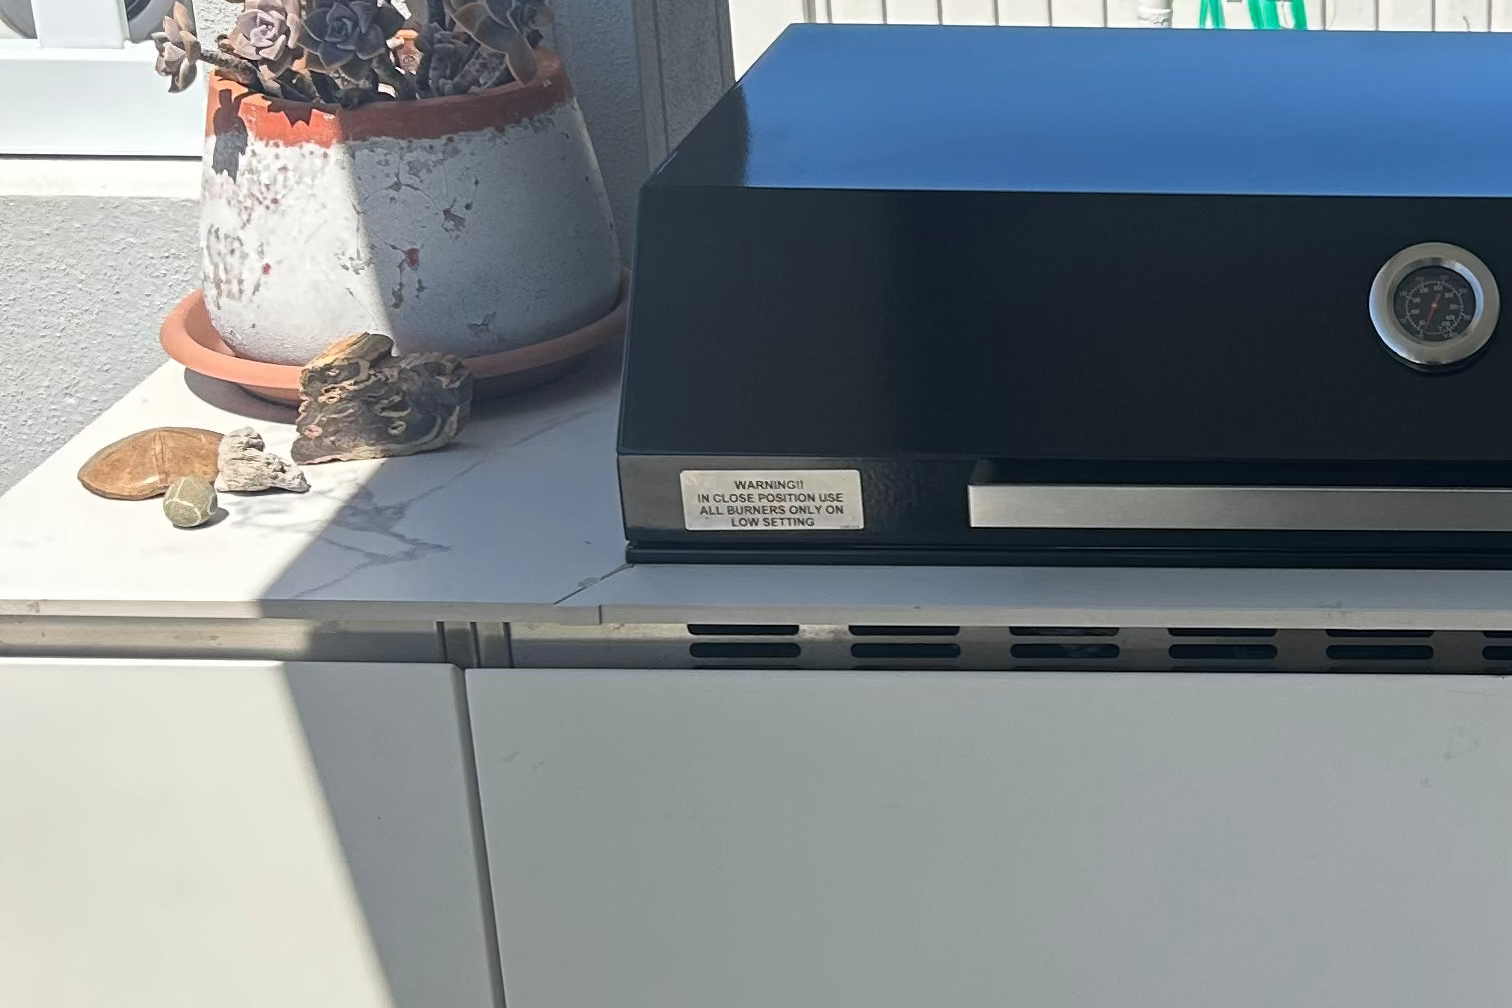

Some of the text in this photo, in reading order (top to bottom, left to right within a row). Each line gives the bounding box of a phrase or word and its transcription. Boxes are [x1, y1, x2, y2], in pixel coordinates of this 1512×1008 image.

[733, 480, 804, 490] WARNING!!
[697, 493, 844, 503] IN CLOSE POSITION USE
[700, 505, 844, 515] ALL BURNERS ONLY ON
[731, 517, 815, 527] LOW SETTING
